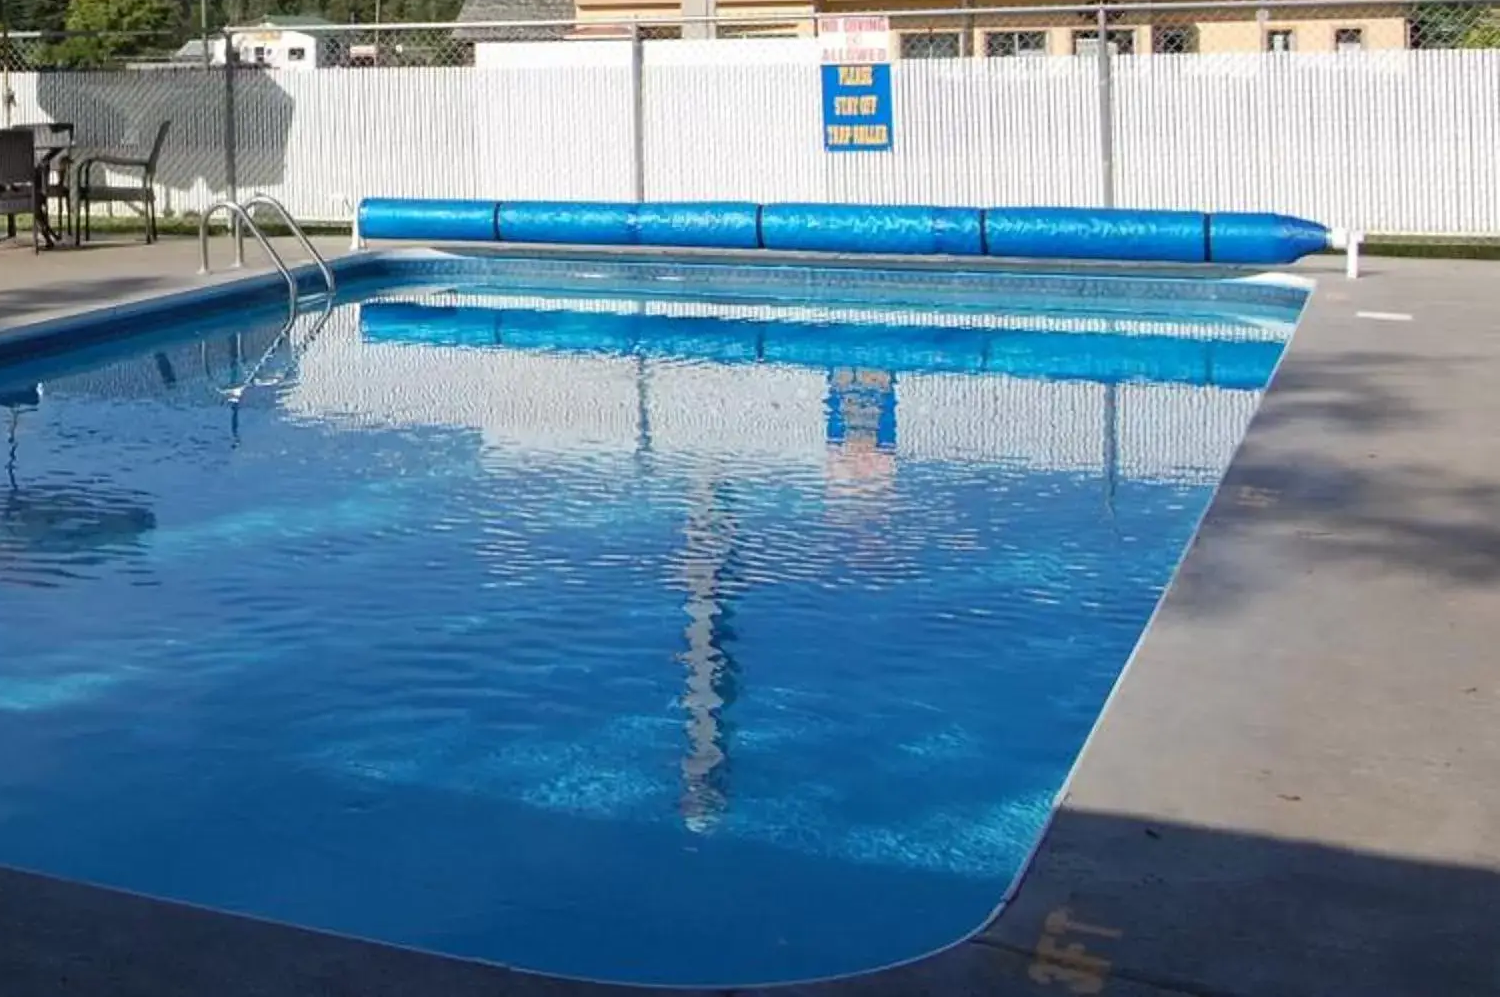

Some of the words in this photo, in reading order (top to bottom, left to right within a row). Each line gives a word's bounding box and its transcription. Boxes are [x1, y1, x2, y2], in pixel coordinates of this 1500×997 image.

[821, 20, 838, 32] NO
[843, 19, 887, 32] DIVING
[821, 48, 887, 61] ALLOWED
